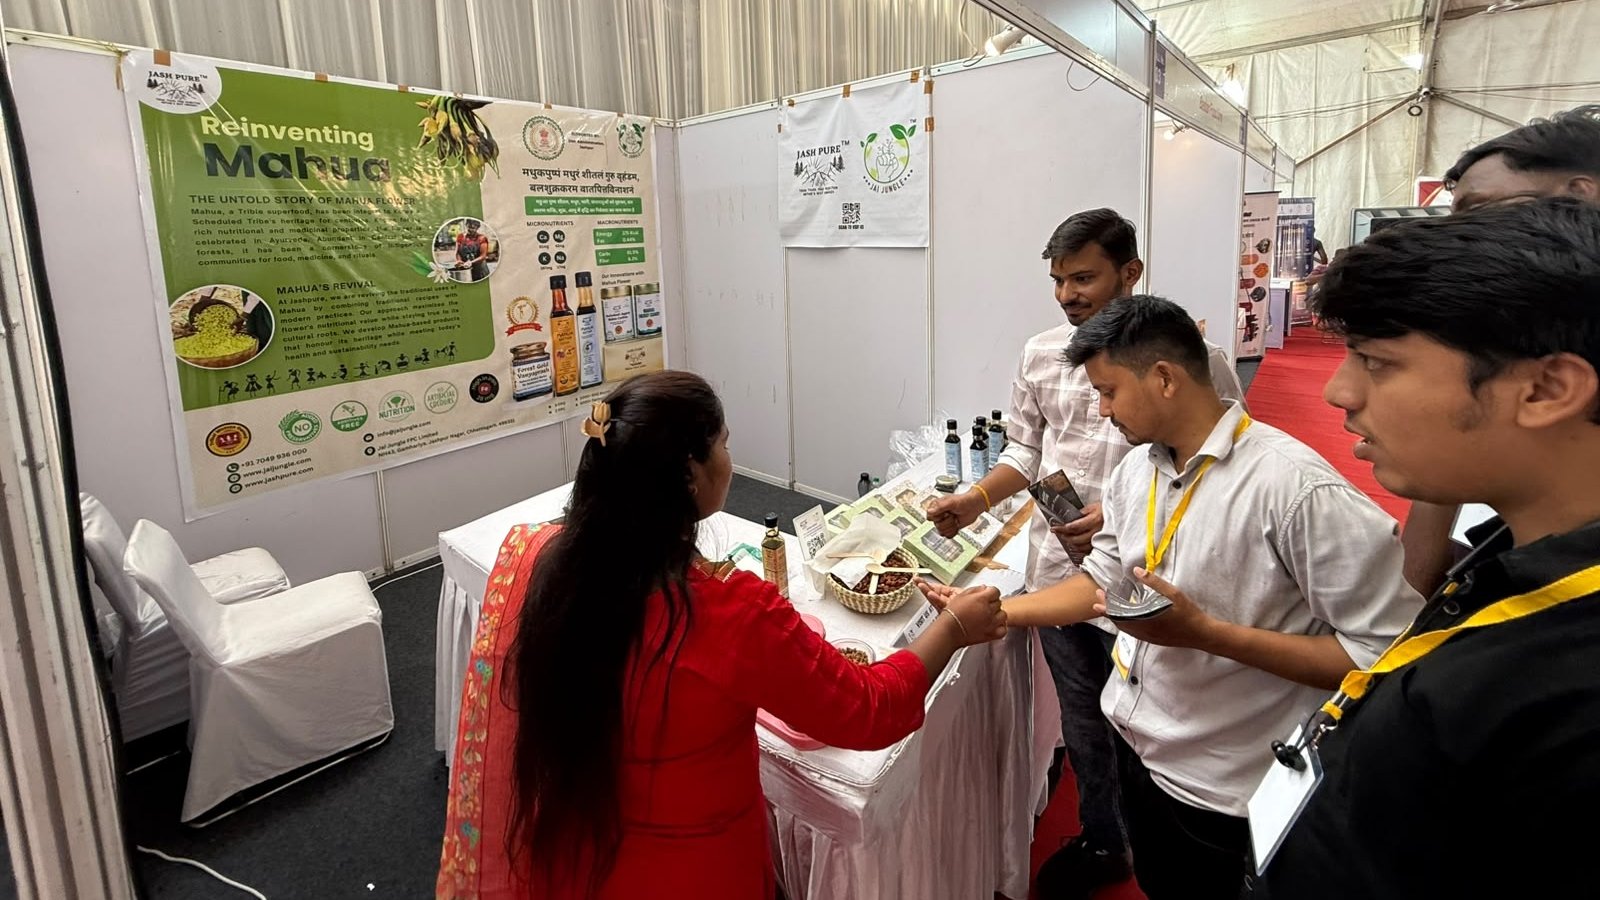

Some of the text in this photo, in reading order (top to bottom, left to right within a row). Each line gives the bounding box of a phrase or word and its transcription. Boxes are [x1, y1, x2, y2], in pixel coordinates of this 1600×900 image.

[148, 71, 200, 82] JASH PURE
[201, 116, 374, 151] Reinventing
[797, 149, 816, 160] JASH
[818, 145, 841, 156] PURE
[203, 144, 392, 182] Mahua
[582, 169, 604, 179] शीतलं
[870, 178, 905, 193] JAI JUNGLE
[190, 195, 415, 207] THE UNTOLD STORY OF MAHUA FLOWER
[281, 218, 314, 226] heritage
[198, 258, 256, 266] communities
[298, 254, 335, 262] medicine,
[277, 280, 376, 294] MAHUA'S REVIVAL
[331, 301, 369, 310] combining
[282, 325, 313, 333] flower's
[317, 320, 356, 329] nutritional
[283, 333, 314, 342] cultural
[389, 320, 431, 328] Mahua-based
[329, 344, 377, 354] sustainability
[427, 391, 455, 402] ARTIFICIAL
[379, 405, 416, 419] NUTRITION
[294, 423, 310, 433] NO
[341, 422, 360, 430] FREE
[377, 421, 431, 438] info@jaijungle.com
[387, 440, 406, 449] Jungle
[418, 431, 438, 440] Limited
[428, 435, 448, 445] Jashpur
[256, 456, 275, 464] 7049
[292, 448, 308, 456] 000
[243, 457, 311, 478] www.jaijungle.com
[244, 466, 314, 488] www.jashpure.com
[915, 615, 925, 628] VISIT
